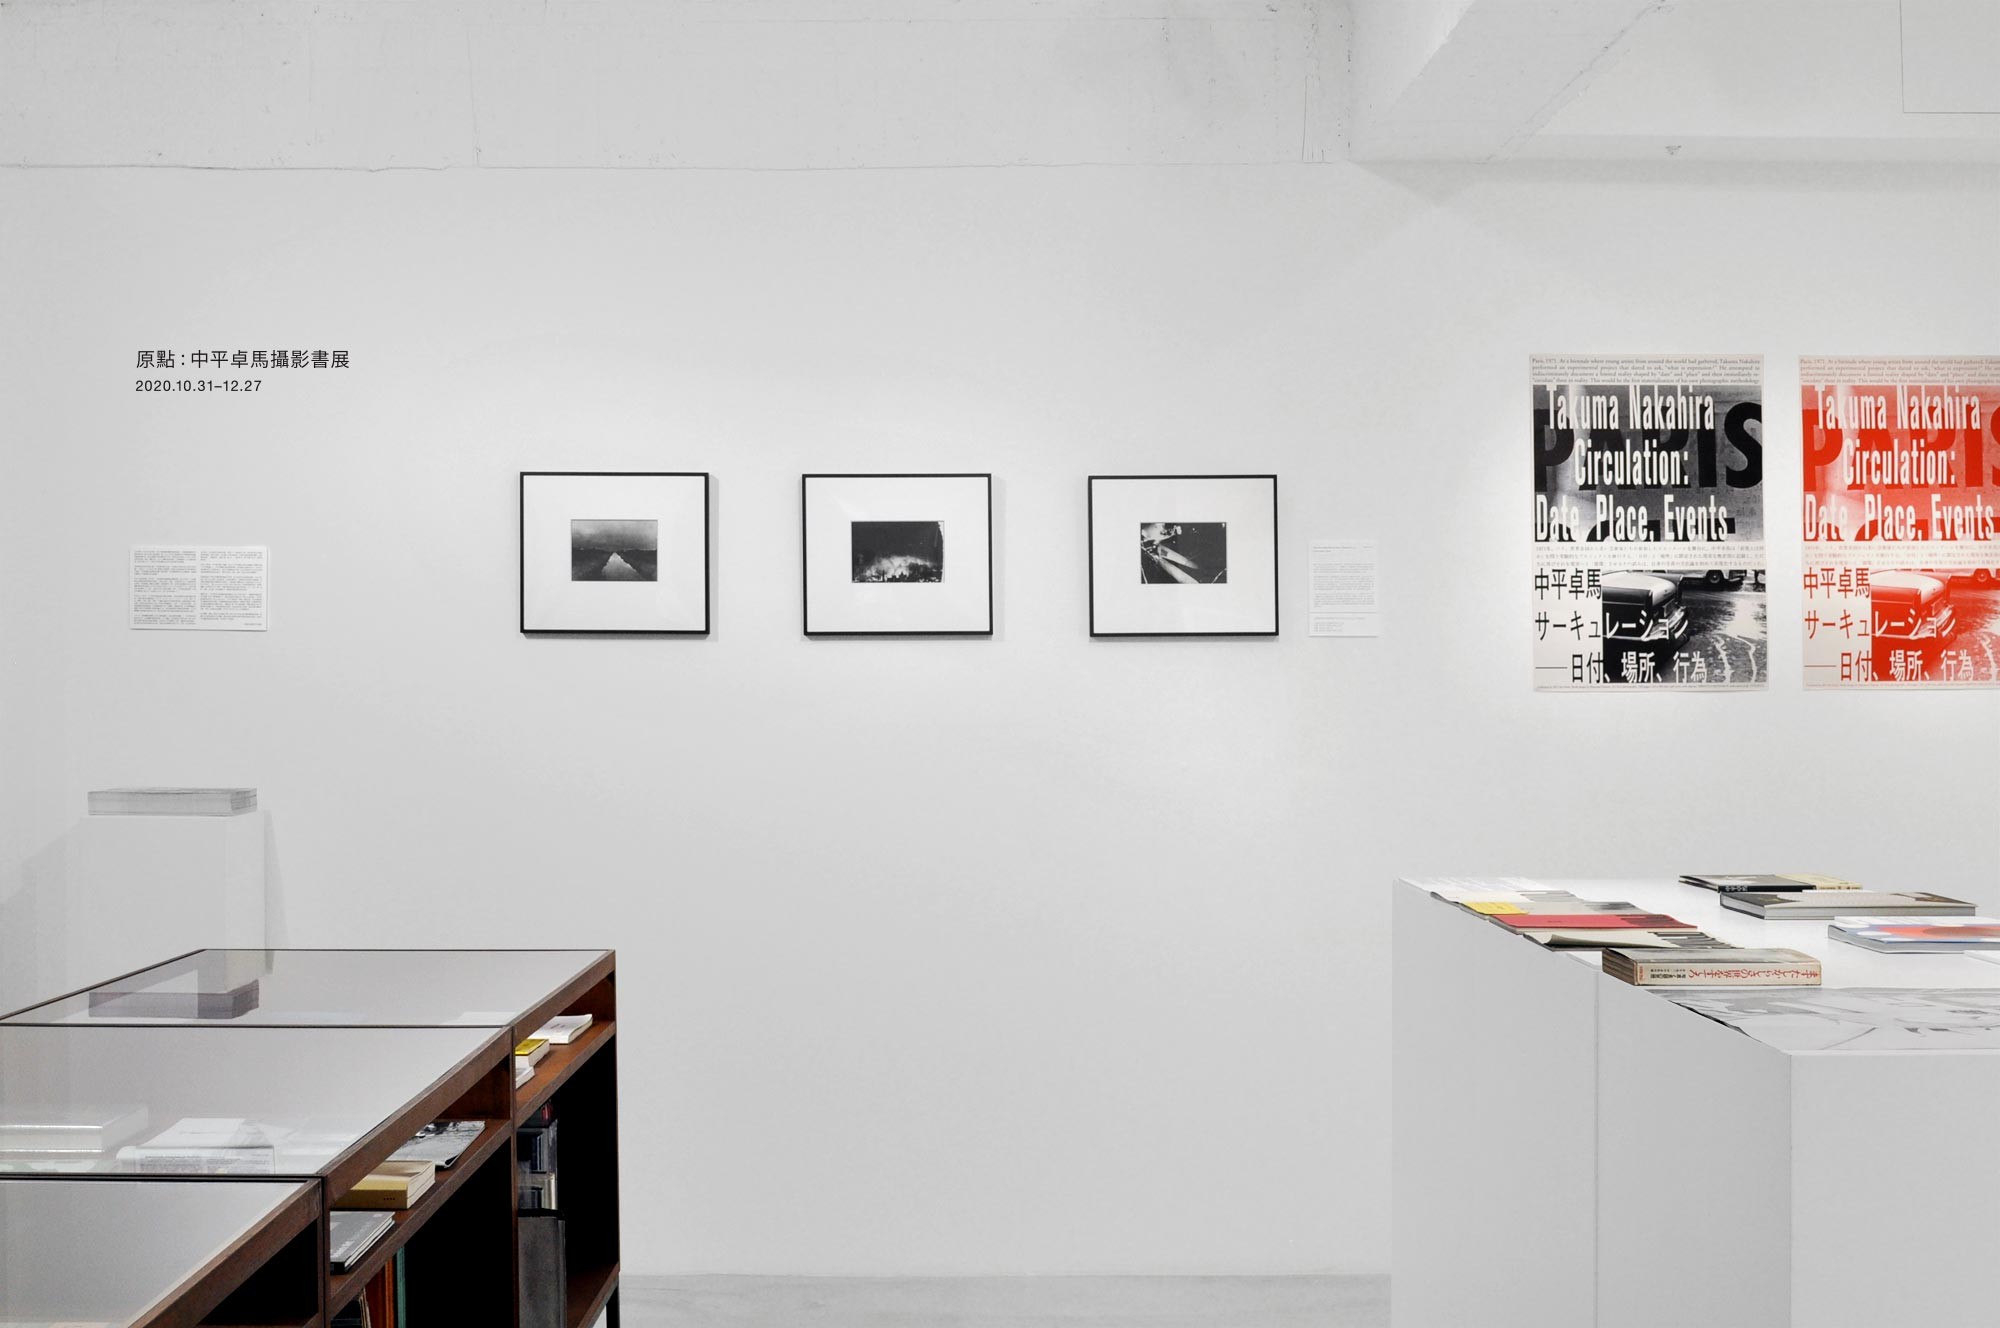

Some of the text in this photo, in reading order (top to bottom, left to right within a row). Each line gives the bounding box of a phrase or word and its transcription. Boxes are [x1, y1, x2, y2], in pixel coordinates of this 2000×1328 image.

[1546, 385, 1715, 429] Takuma Nakahira
[1814, 385, 1981, 429] Takuma Nakahira
[1574, 438, 1689, 486] Circulation:
[1802, 405, 2000, 492] PARI
[1843, 438, 1956, 485] Circulation:
[1664, 494, 1728, 541] Events
[1931, 493, 1994, 540] Events
[1534, 567, 1601, 600] 中平卓馬
[1803, 567, 1871, 599] 中平卓馬
[1535, 610, 1689, 641] サーキュレーション
[1804, 608, 1956, 640] サーキュレーション
